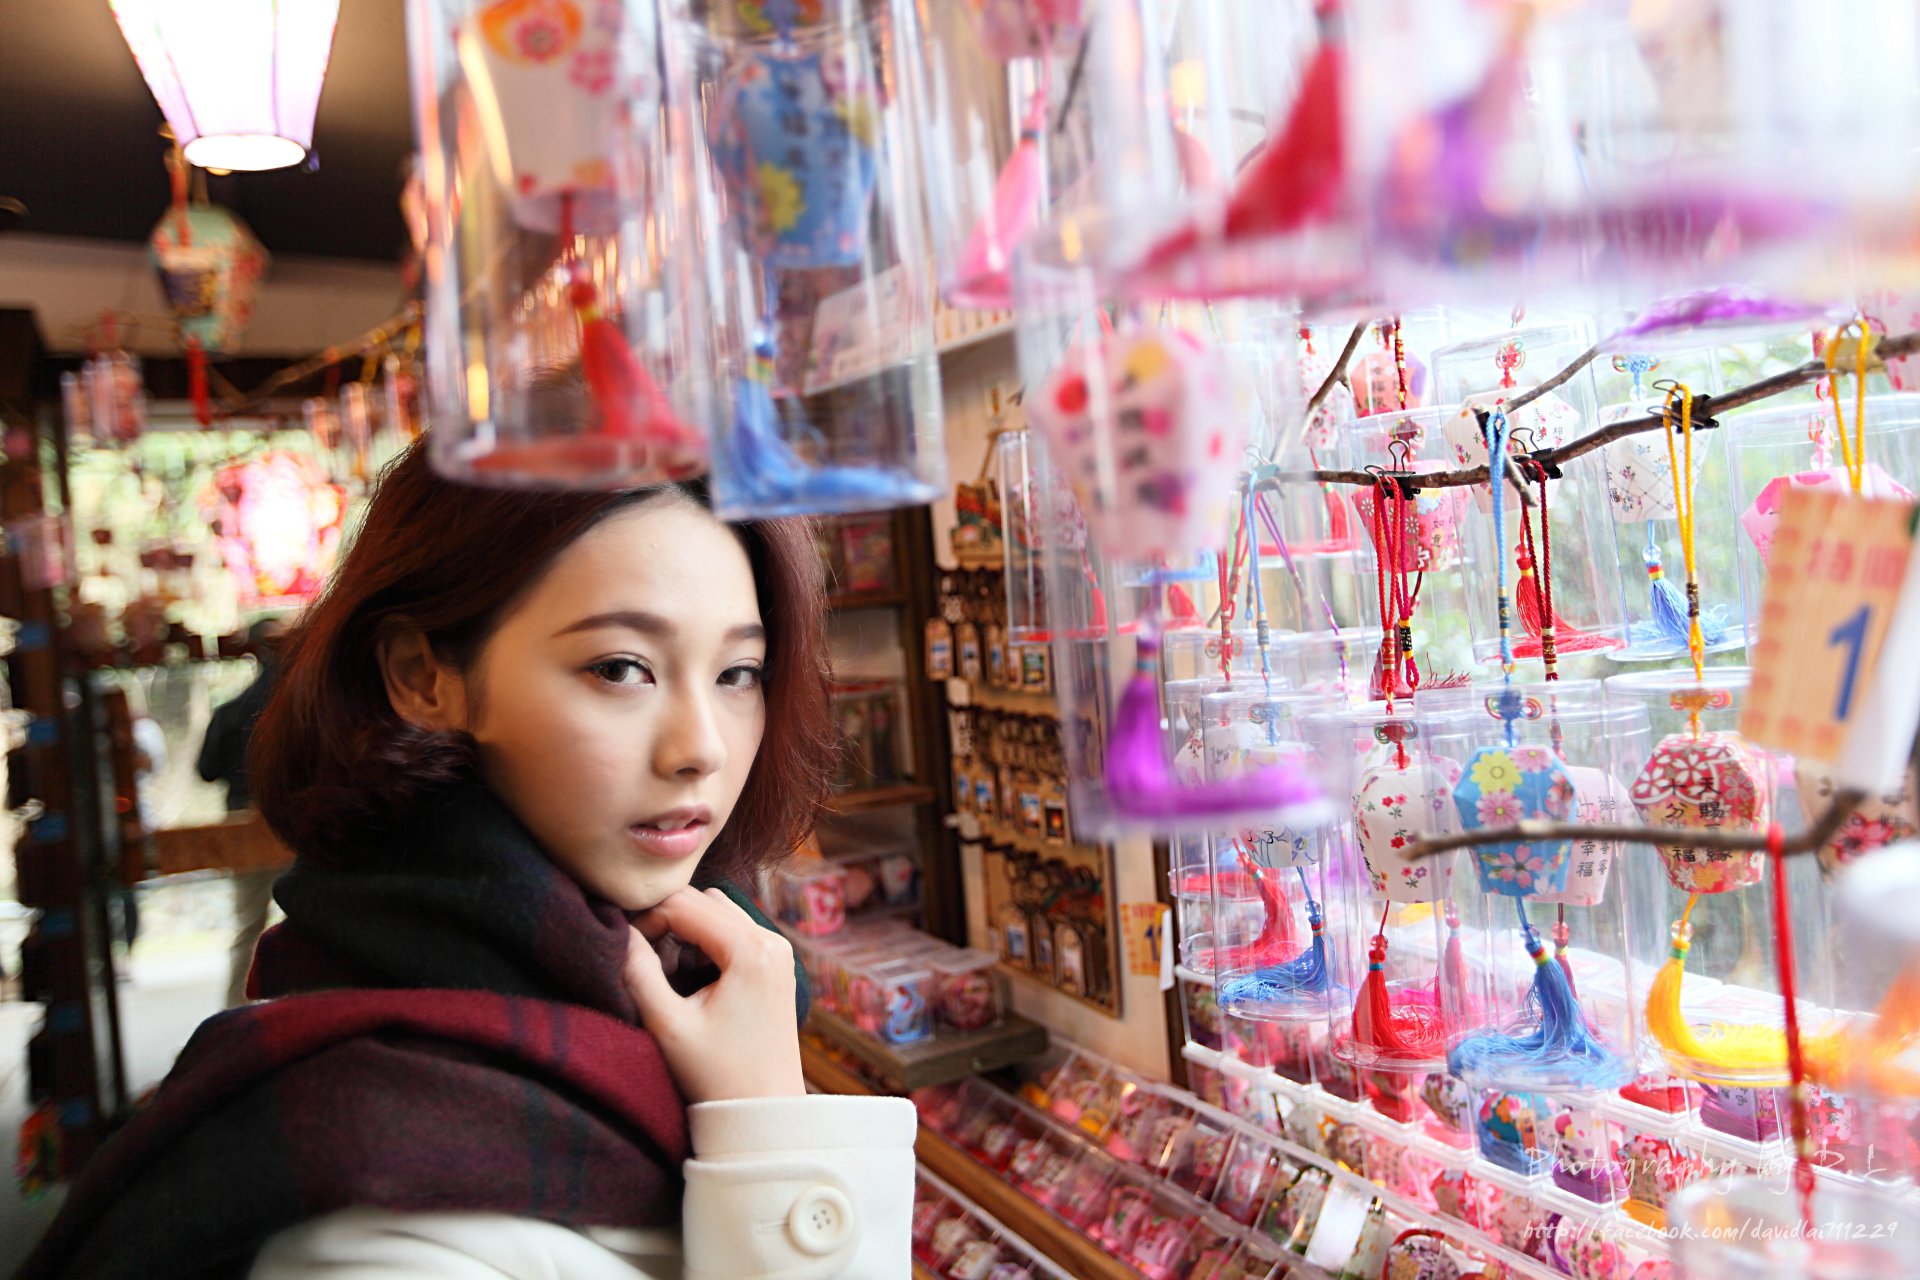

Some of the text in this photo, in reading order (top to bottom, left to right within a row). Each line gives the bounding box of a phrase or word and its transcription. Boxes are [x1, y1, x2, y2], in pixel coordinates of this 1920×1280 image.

[1575, 790, 1596, 878] 十幸福
[1662, 777, 1697, 863] 十分福
[1697, 776, 1733, 863] 天賜緣
